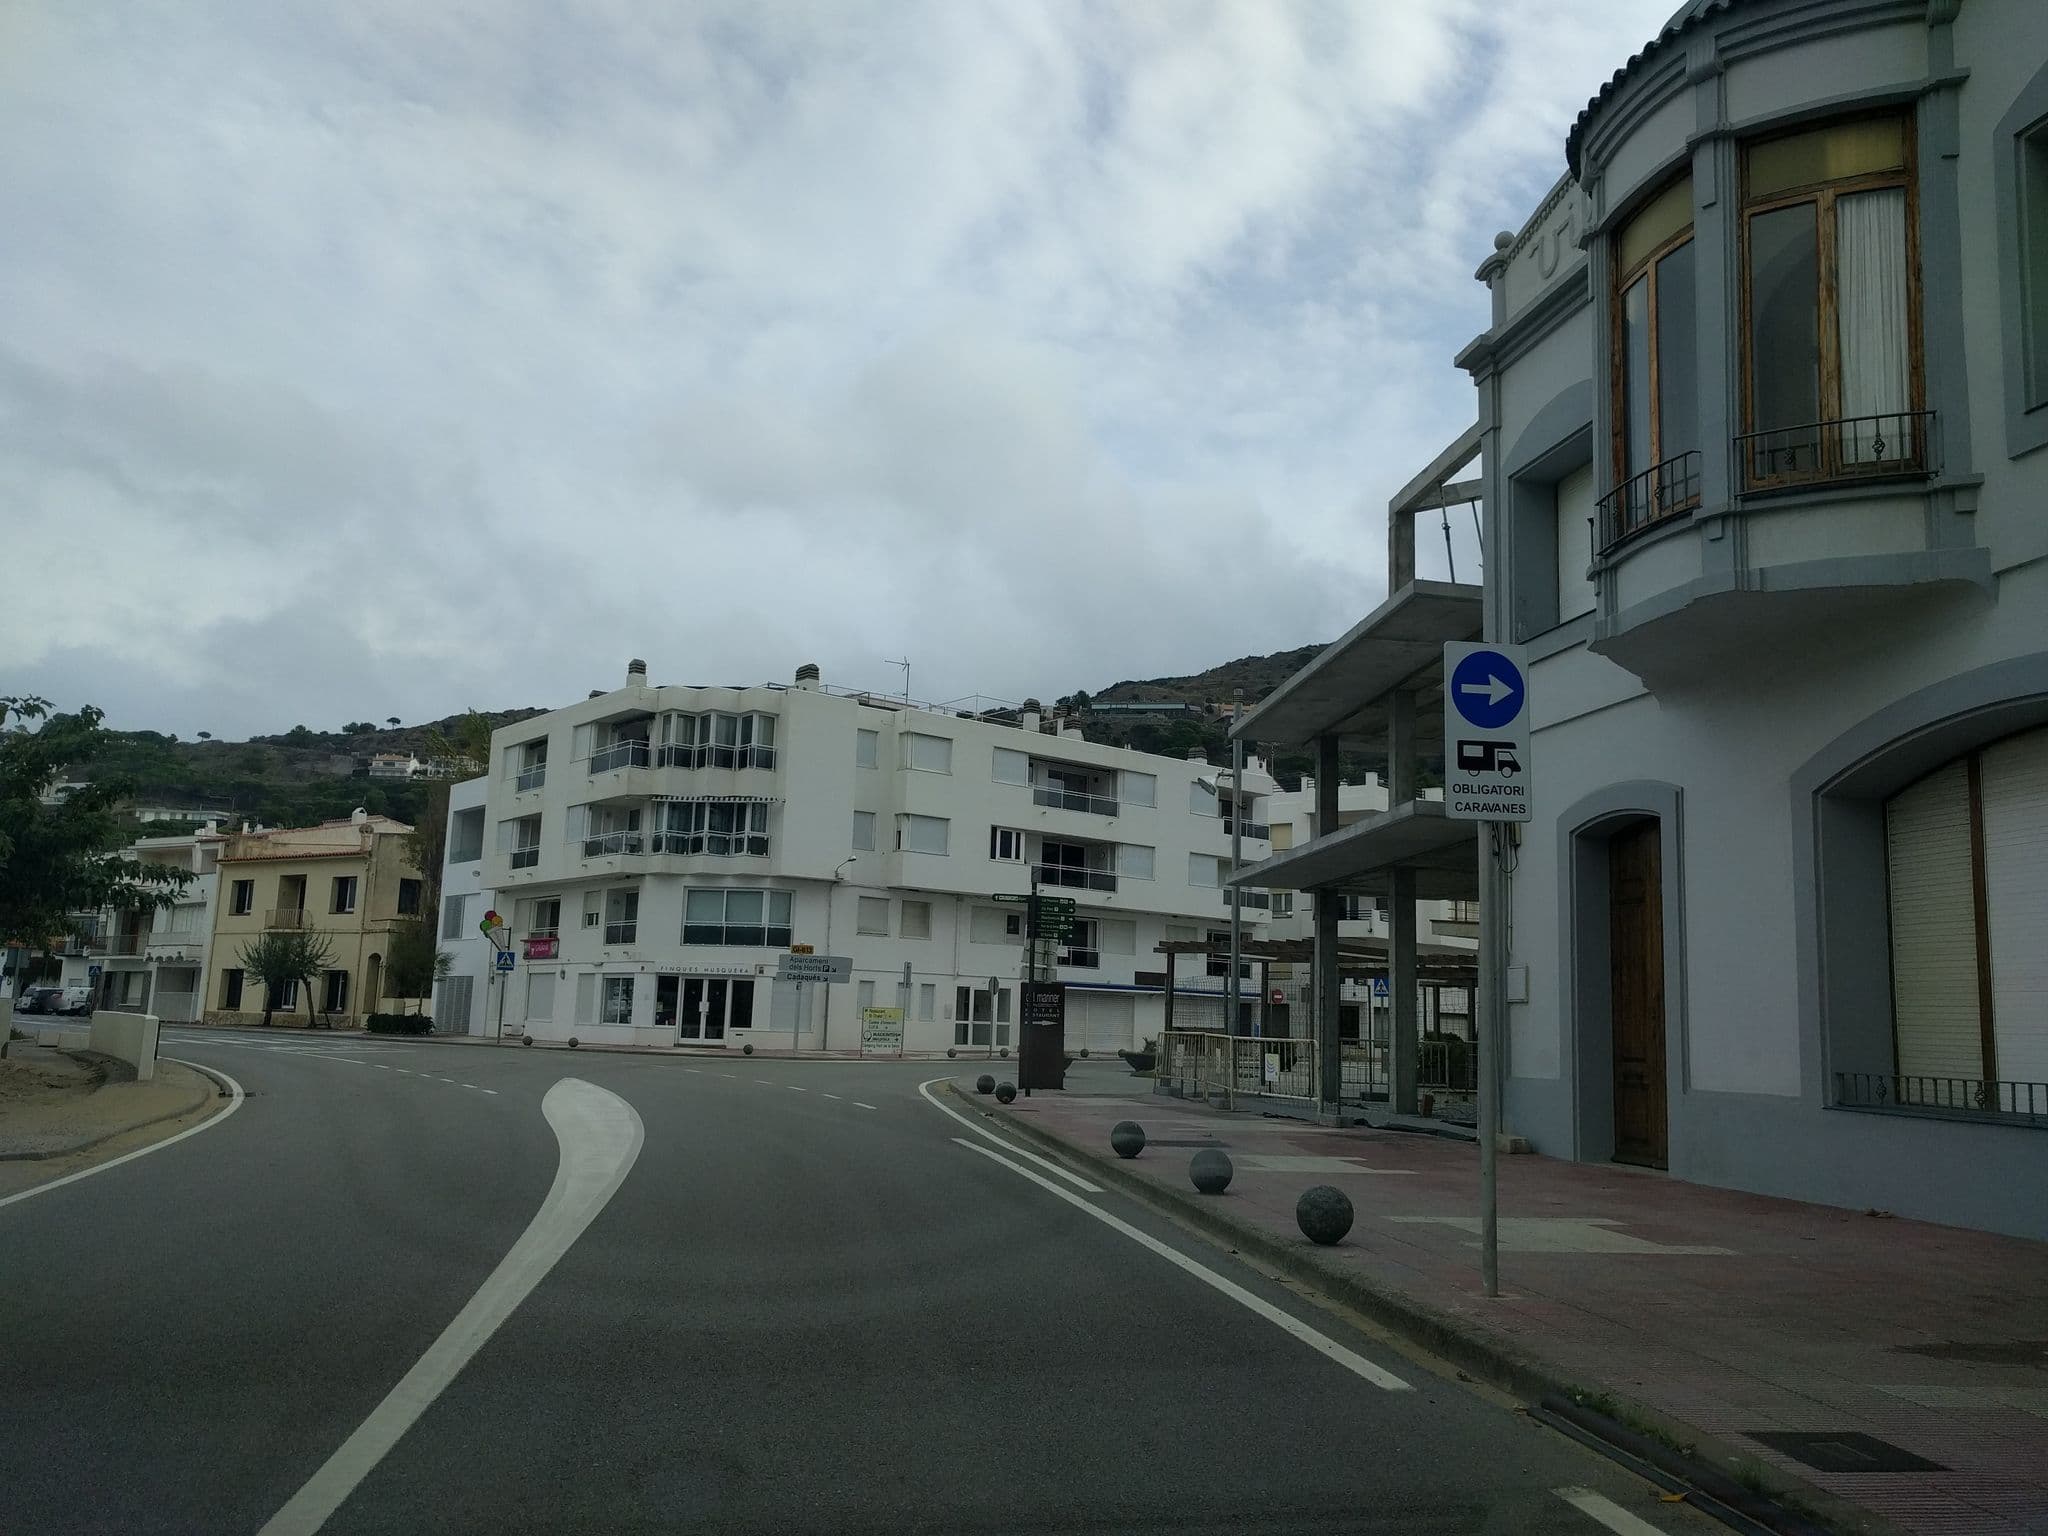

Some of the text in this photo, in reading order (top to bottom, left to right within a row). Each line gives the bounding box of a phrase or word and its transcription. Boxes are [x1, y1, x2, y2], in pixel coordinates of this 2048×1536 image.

[1453, 784, 1525, 796] OBLIGATORI
[1455, 802, 1526, 814] CARAVANES
[789, 956, 829, 965] Aparcament
[788, 963, 803, 971] dels
[786, 973, 821, 982] Cadaqués
